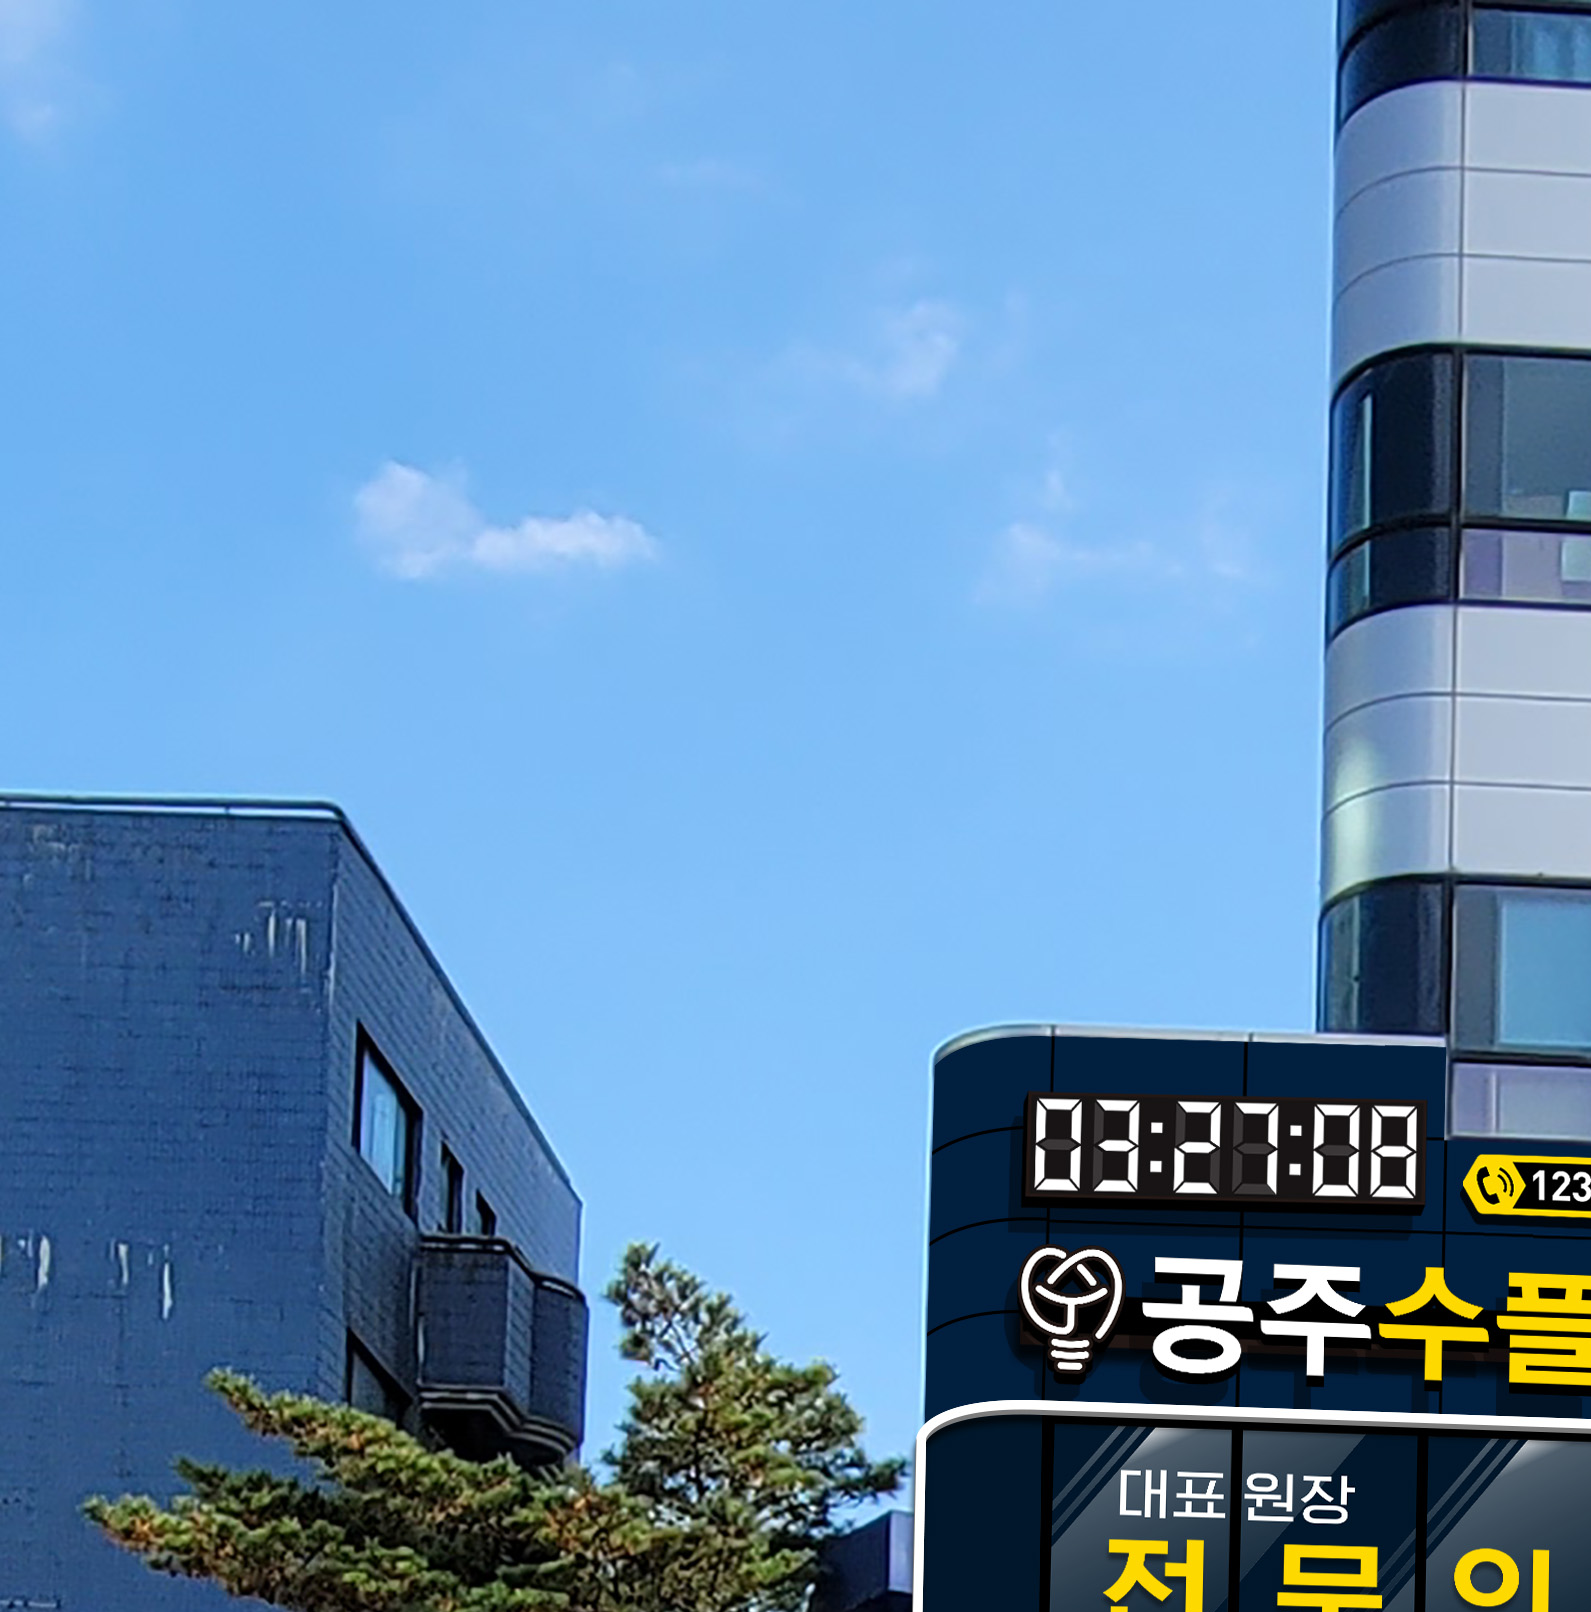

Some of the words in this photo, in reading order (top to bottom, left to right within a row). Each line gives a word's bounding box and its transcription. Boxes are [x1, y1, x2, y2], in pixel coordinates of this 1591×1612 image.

[1034, 1098, 1418, 1198] 03:27:08
[1117, 1468, 1227, 1522] 대표
[1242, 1467, 1356, 1526] 원장
